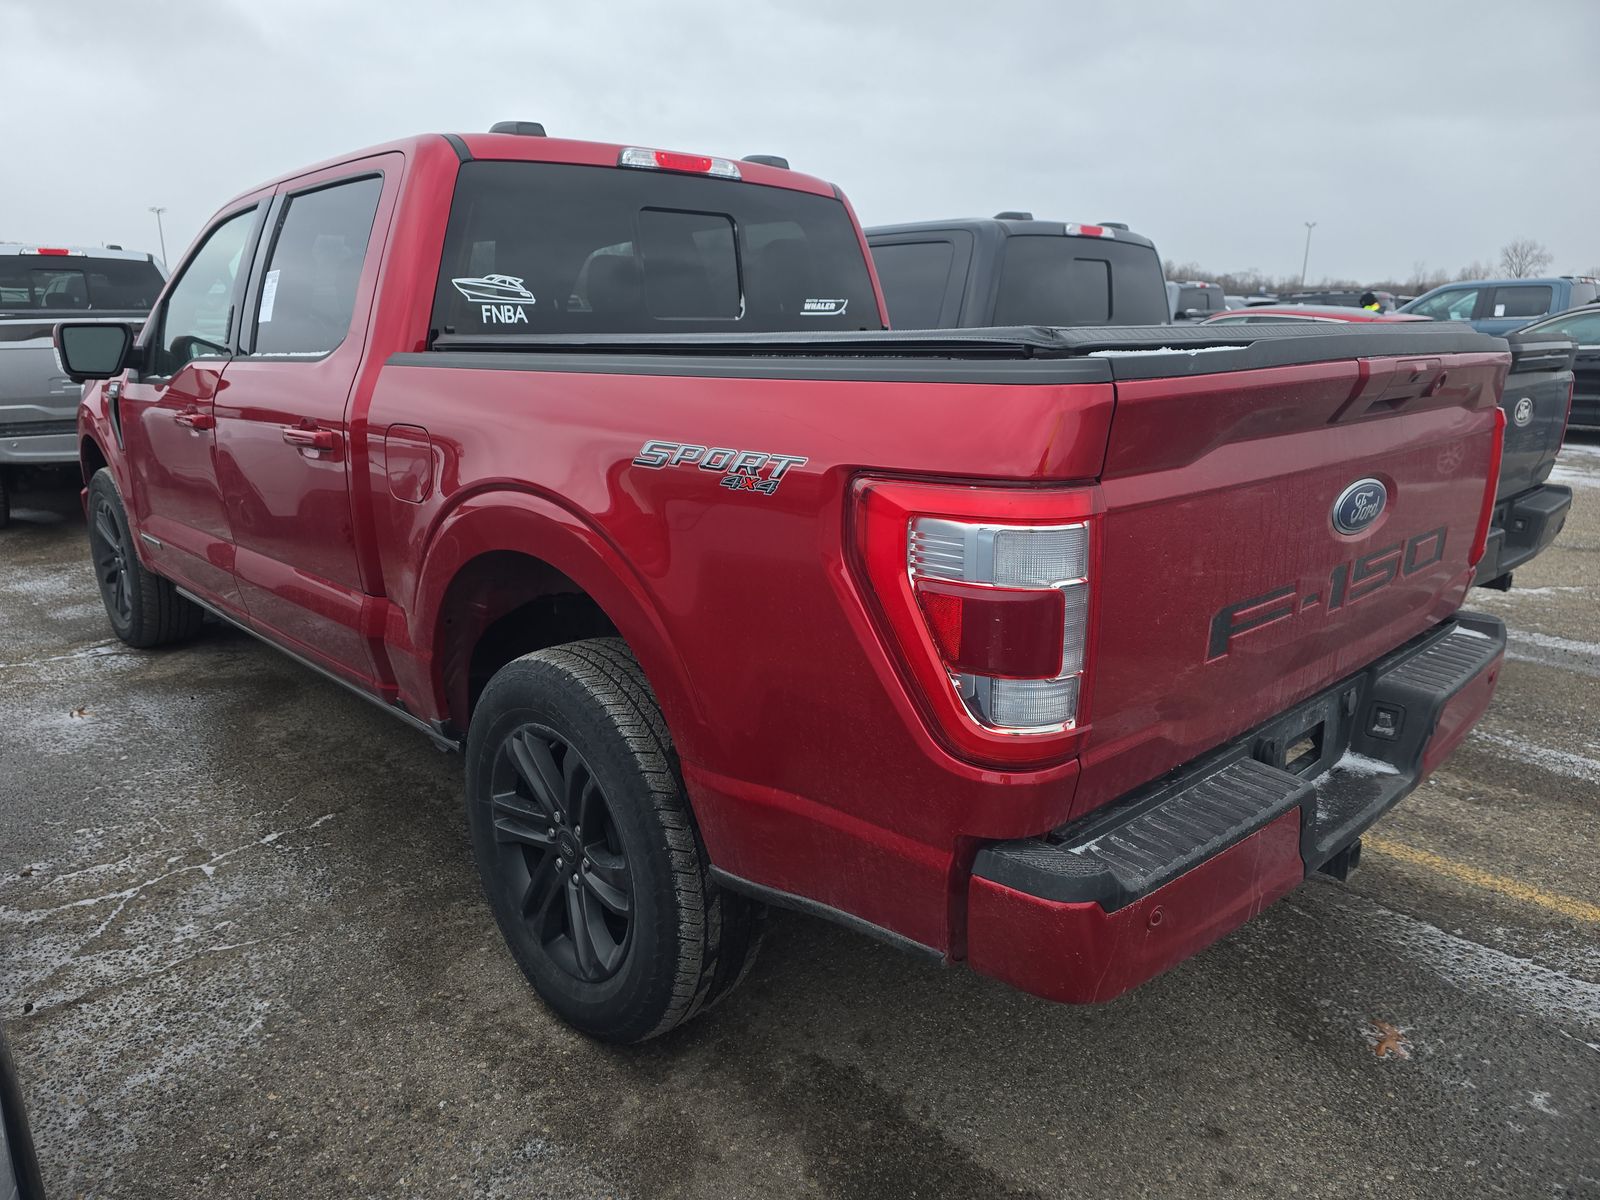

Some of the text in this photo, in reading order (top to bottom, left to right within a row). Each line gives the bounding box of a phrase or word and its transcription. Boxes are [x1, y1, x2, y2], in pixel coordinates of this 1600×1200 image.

[481, 304, 529, 324] FNBA
[804, 302, 836, 310] WHALER
[632, 440, 809, 480] SPORT
[1350, 491, 1380, 524] Ford
[1205, 526, 1448, 664] F-150
